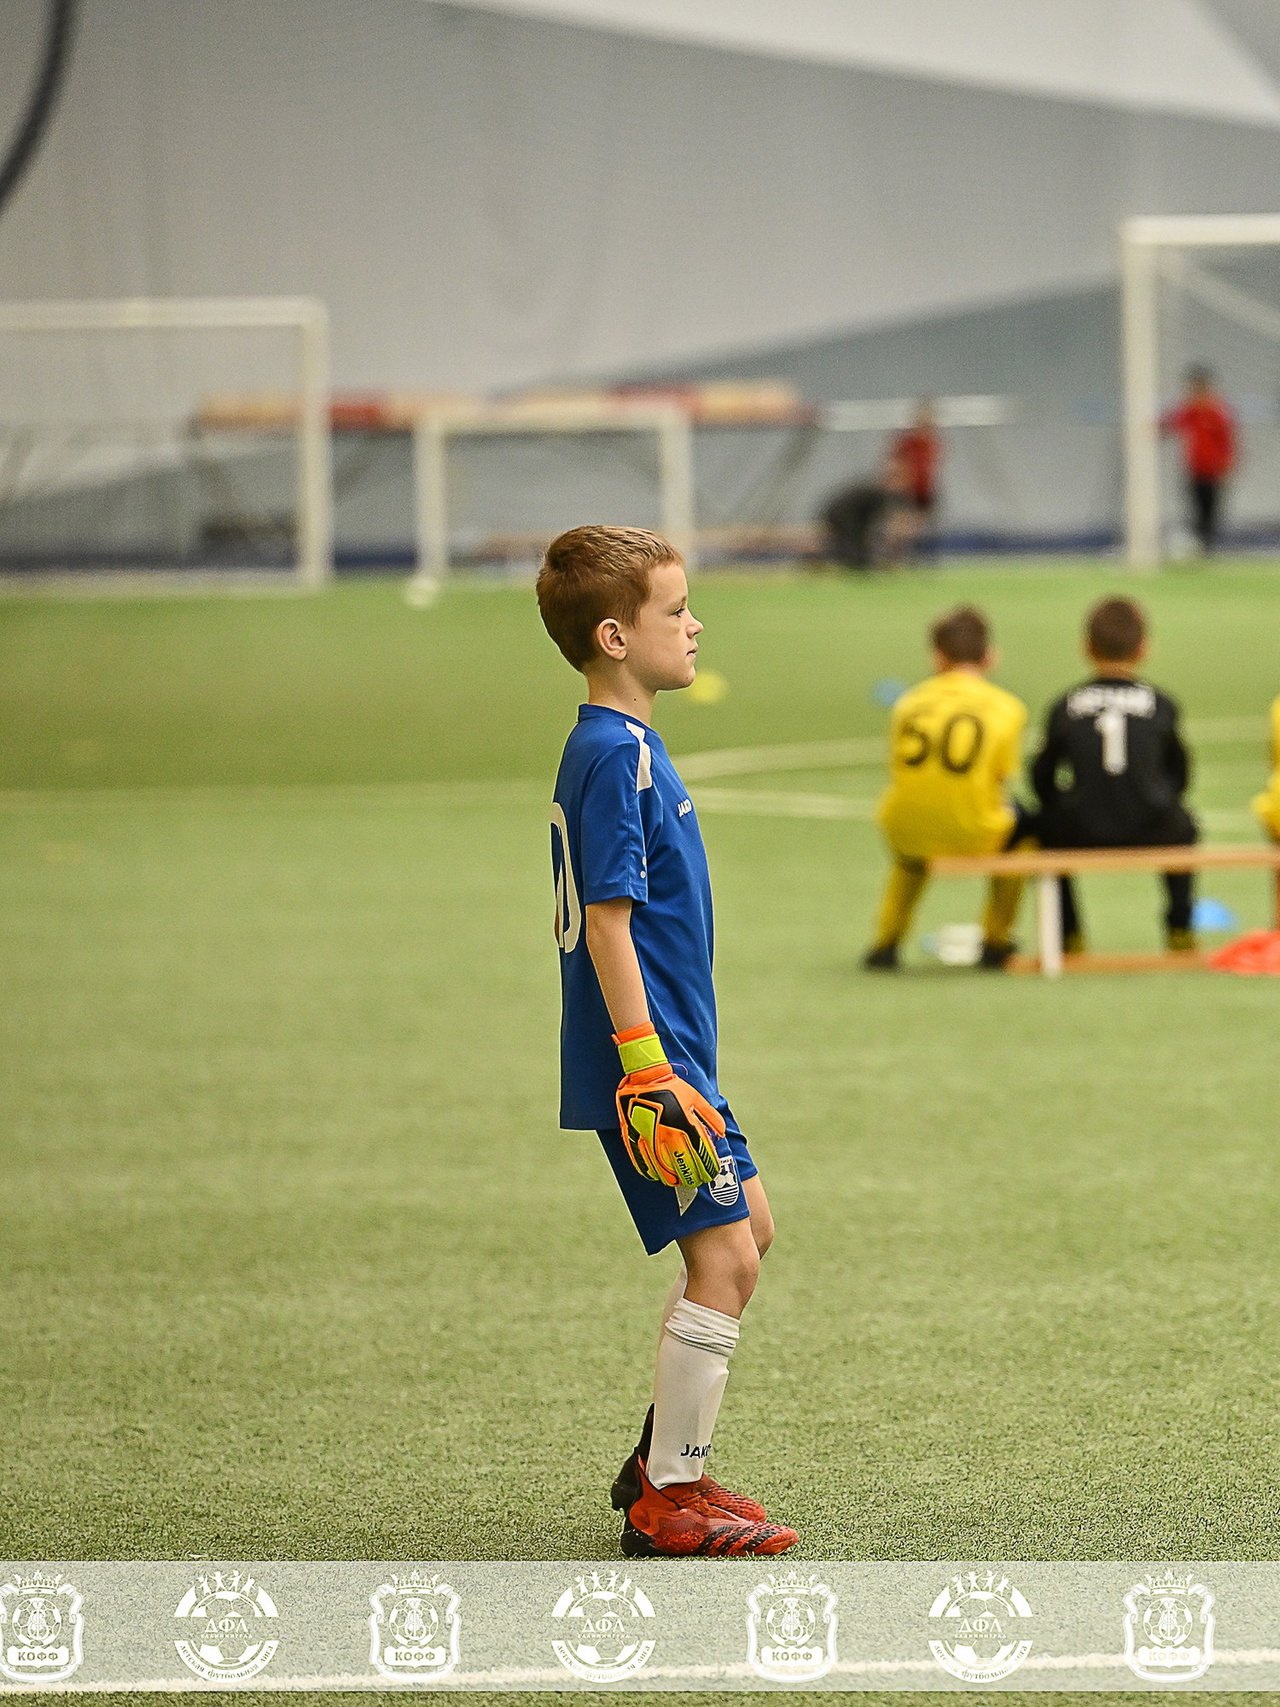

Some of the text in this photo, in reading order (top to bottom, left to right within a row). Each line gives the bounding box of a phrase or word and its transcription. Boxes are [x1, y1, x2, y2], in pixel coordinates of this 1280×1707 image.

[898, 710, 985, 776] 50
[1094, 708, 1128, 776] 1
[674, 1151, 695, 1186] Jenkins
